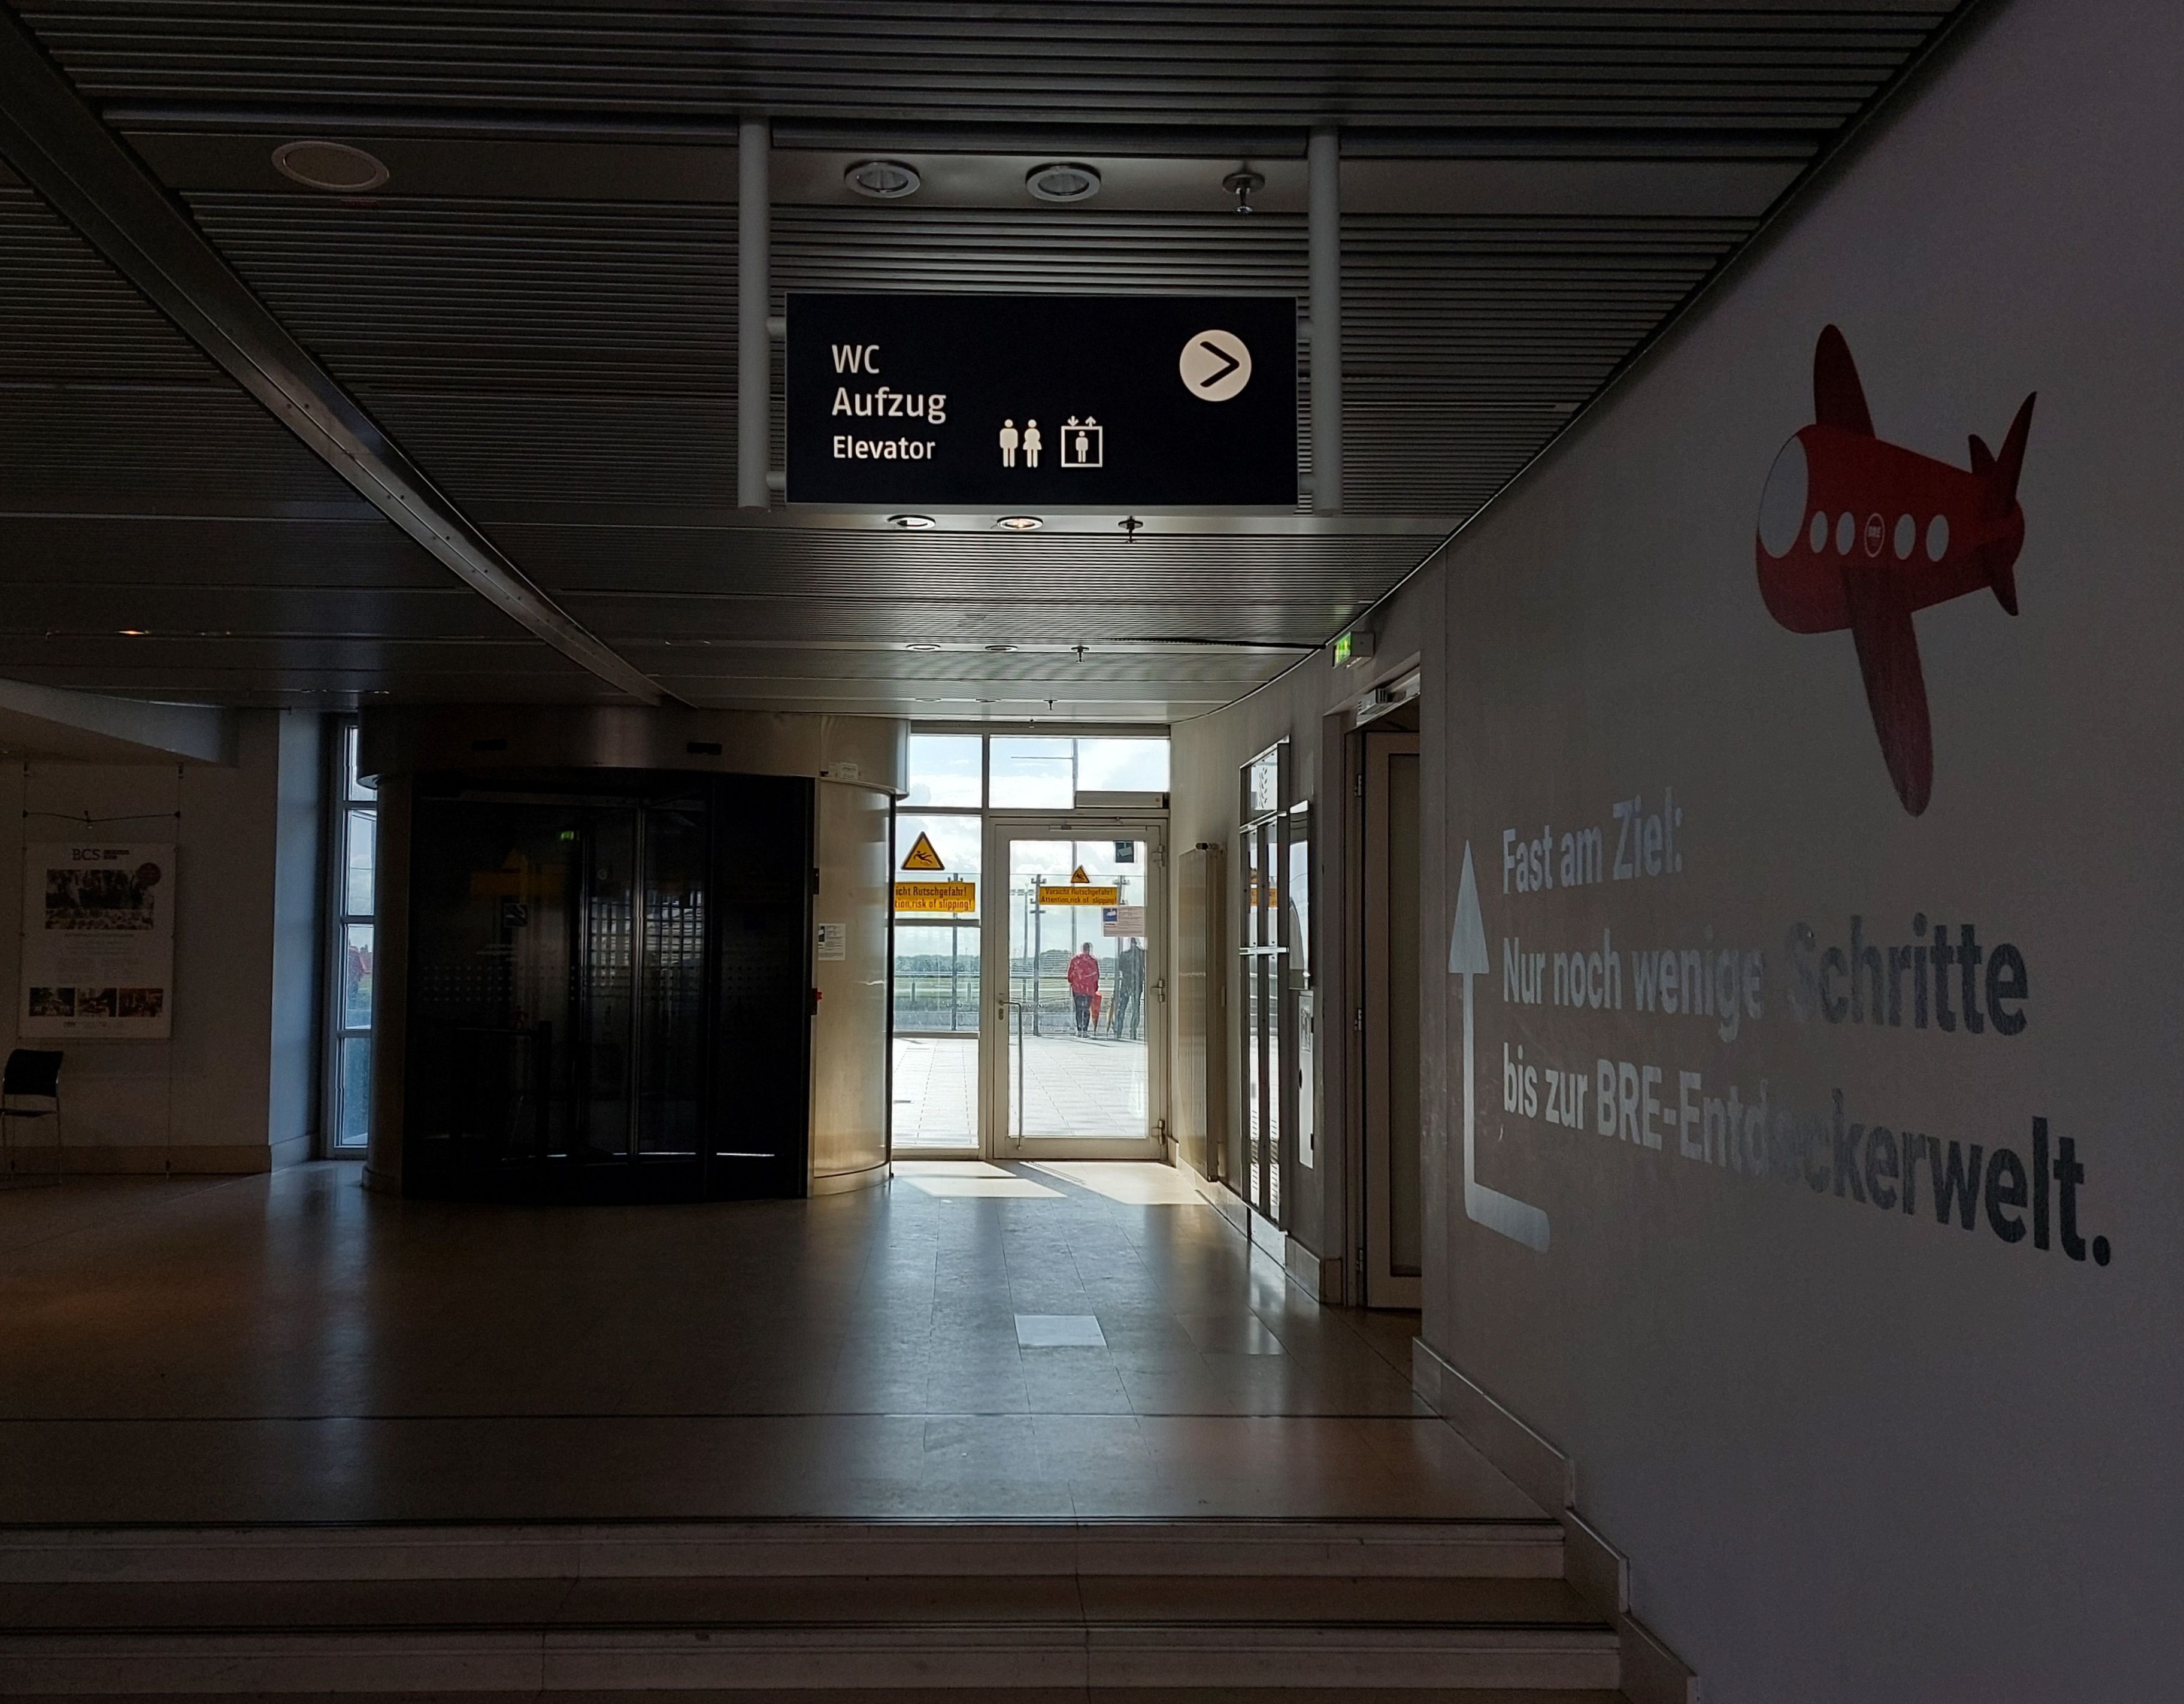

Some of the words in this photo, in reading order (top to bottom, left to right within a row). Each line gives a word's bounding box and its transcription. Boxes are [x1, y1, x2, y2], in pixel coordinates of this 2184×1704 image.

[832, 344, 880, 374] WC
[832, 387, 947, 425] Aufzug
[832, 435, 936, 460] Elevator
[72, 849, 100, 860] BCS
[1503, 826, 1553, 894] Fast
[1560, 825, 1603, 888] am
[1612, 786, 1683, 881] Ziel:
[895, 886, 911, 896] icht
[913, 886, 967, 898] Rutschgefahr!
[929, 899, 936, 908] of
[938, 899, 971, 910] slipping!
[1503, 937, 1545, 1005] Nur
[1554, 928, 1621, 1011] noch
[1632, 925, 1764, 1043] wenige
[1786, 912, 2028, 1036] Schritte
[1503, 1042, 1538, 1118] bis
[1545, 1069, 1588, 1126] zur
